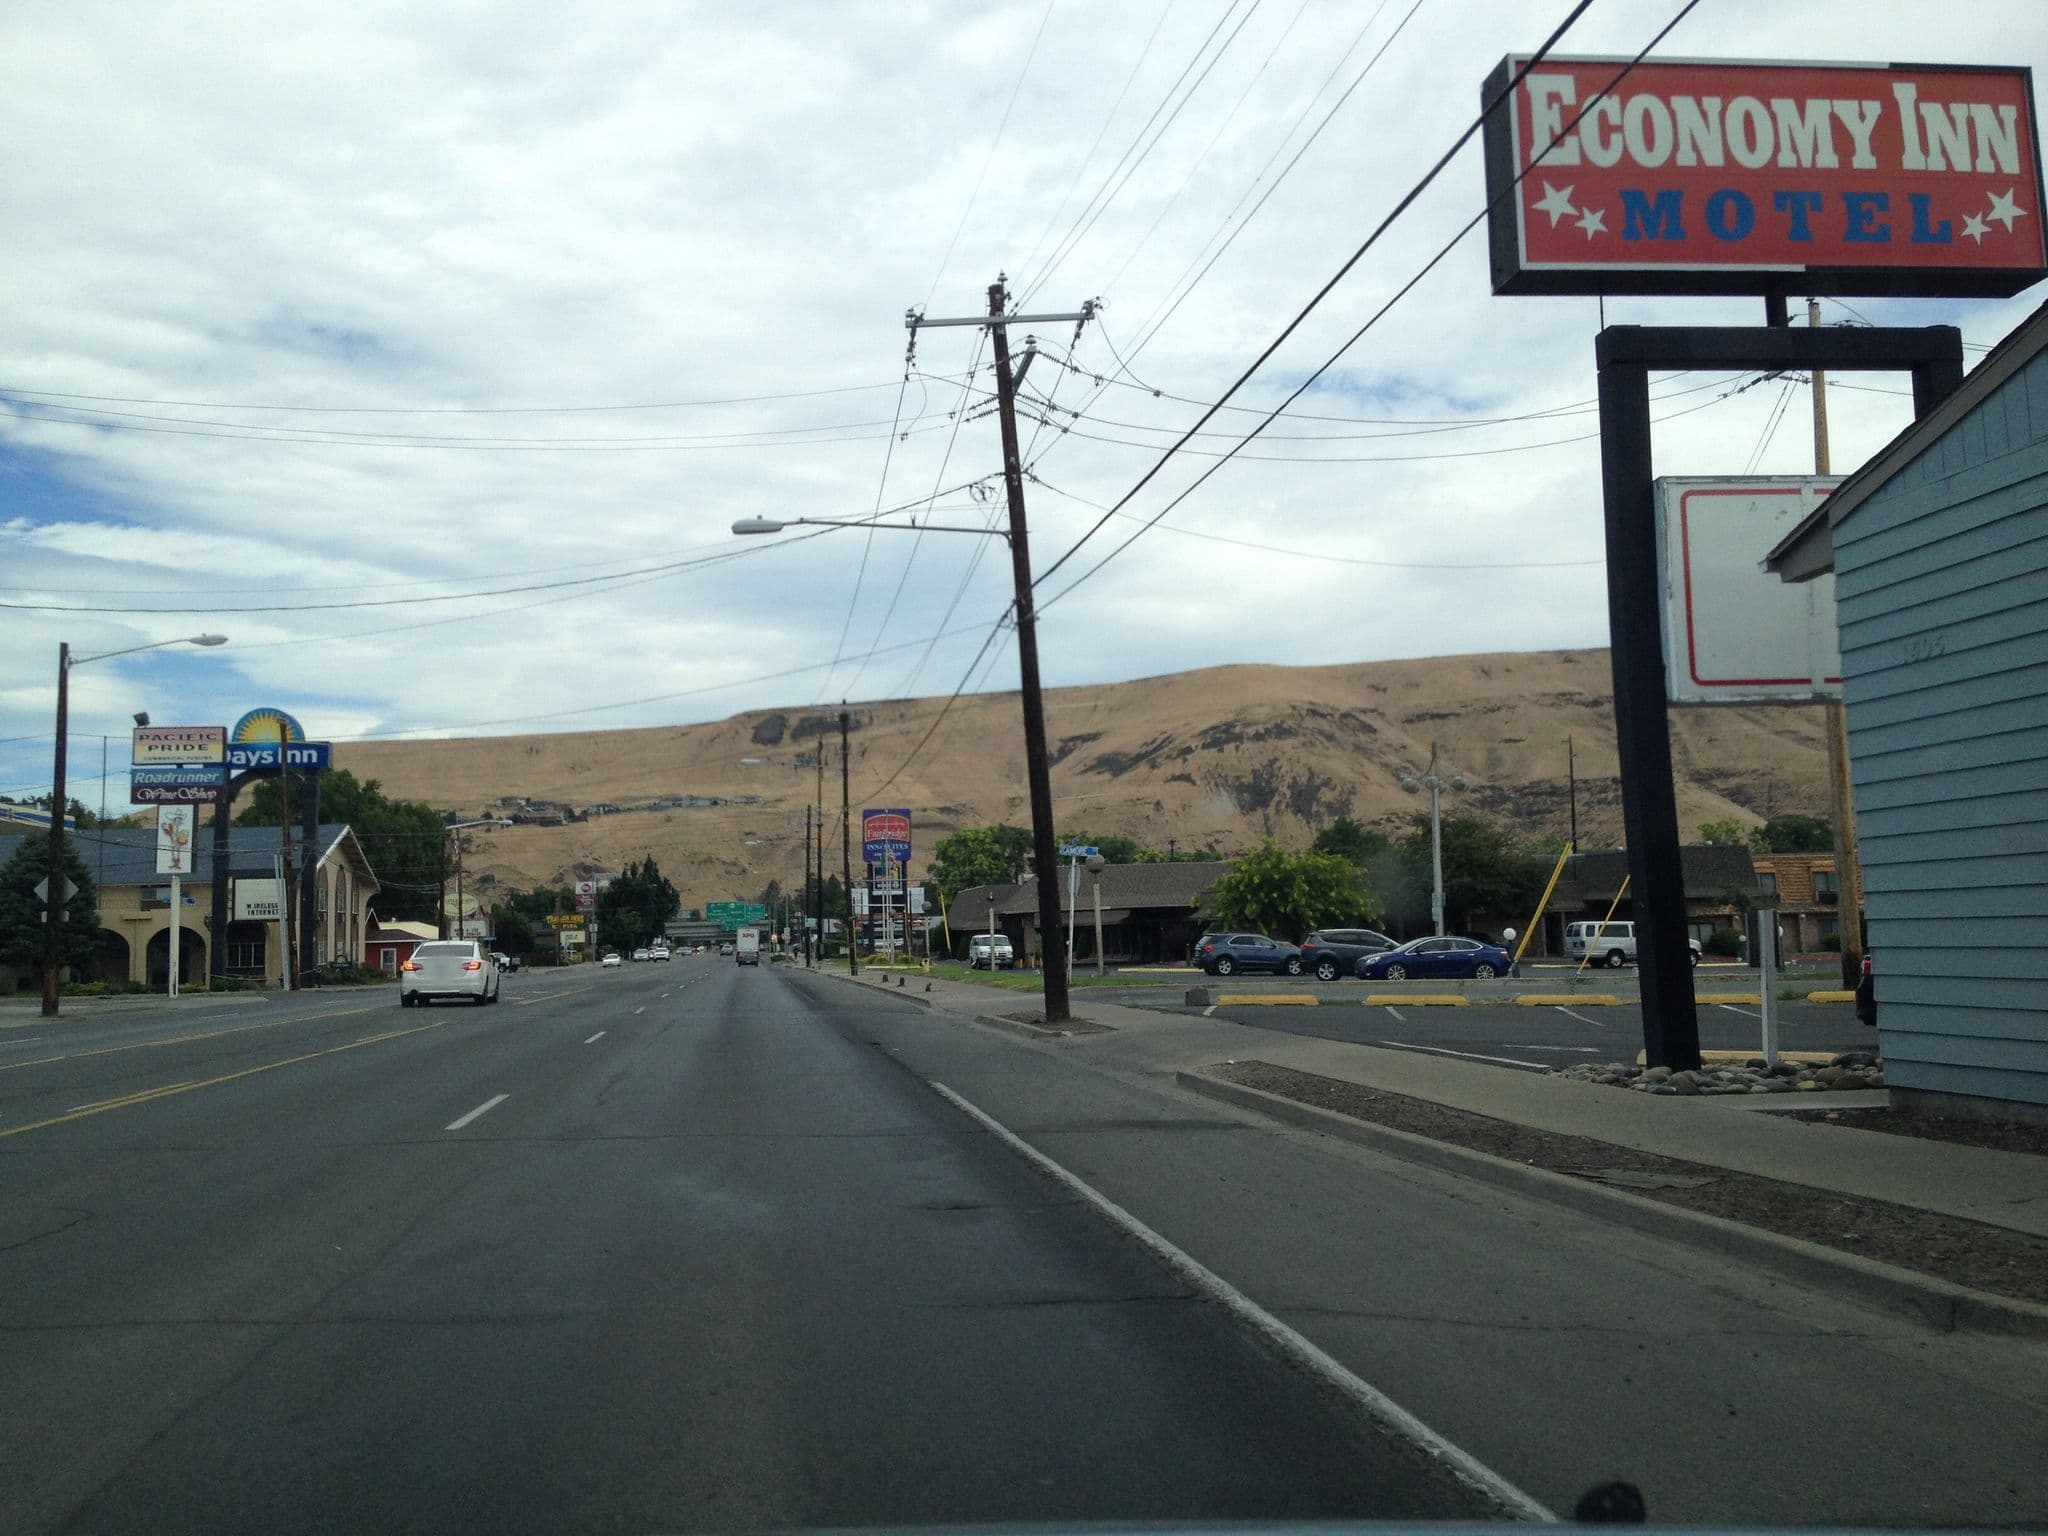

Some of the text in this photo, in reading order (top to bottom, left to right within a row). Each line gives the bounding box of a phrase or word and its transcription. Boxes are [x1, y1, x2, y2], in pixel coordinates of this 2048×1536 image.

[1525, 73, 2020, 175] ECONOMY INN
[1618, 188, 1953, 245] MOTEL
[139, 733, 217, 742] PACIFIC
[148, 744, 209, 752] PRIDE
[278, 746, 318, 764] Inn
[134, 772, 220, 784] Roadrunner
[137, 787, 218, 801] Wine Shop
[742, 931, 755, 939] XPO
